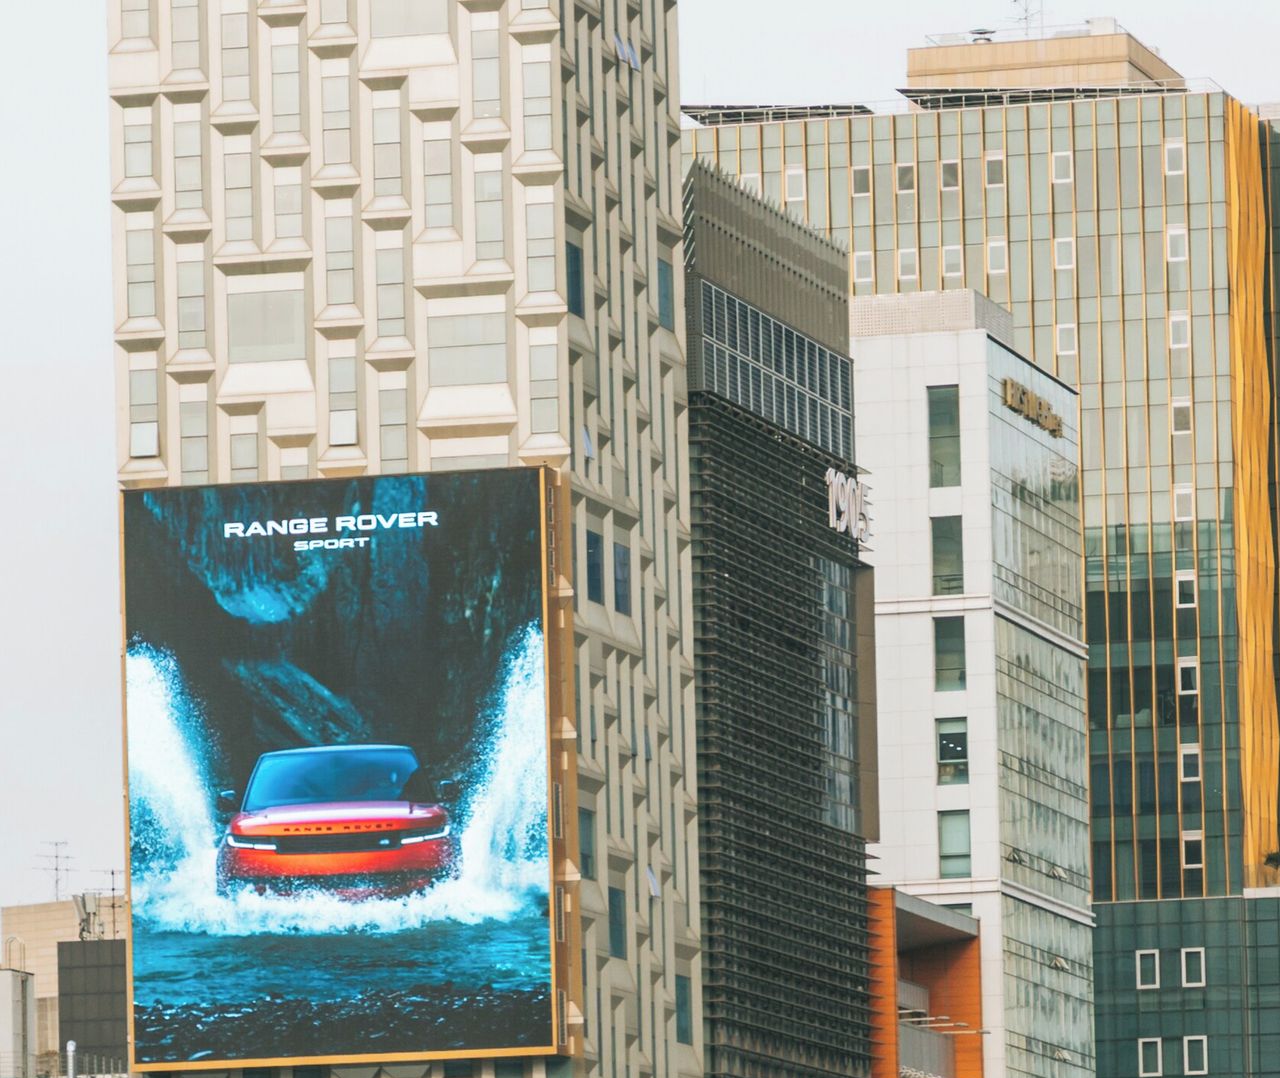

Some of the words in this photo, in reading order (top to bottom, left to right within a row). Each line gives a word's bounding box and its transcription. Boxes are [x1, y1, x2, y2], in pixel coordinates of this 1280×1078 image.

[826, 467, 871, 543] 1905
[224, 517, 328, 538] RANGE
[335, 511, 439, 532] ROVER
[294, 537, 370, 551] SPORT
